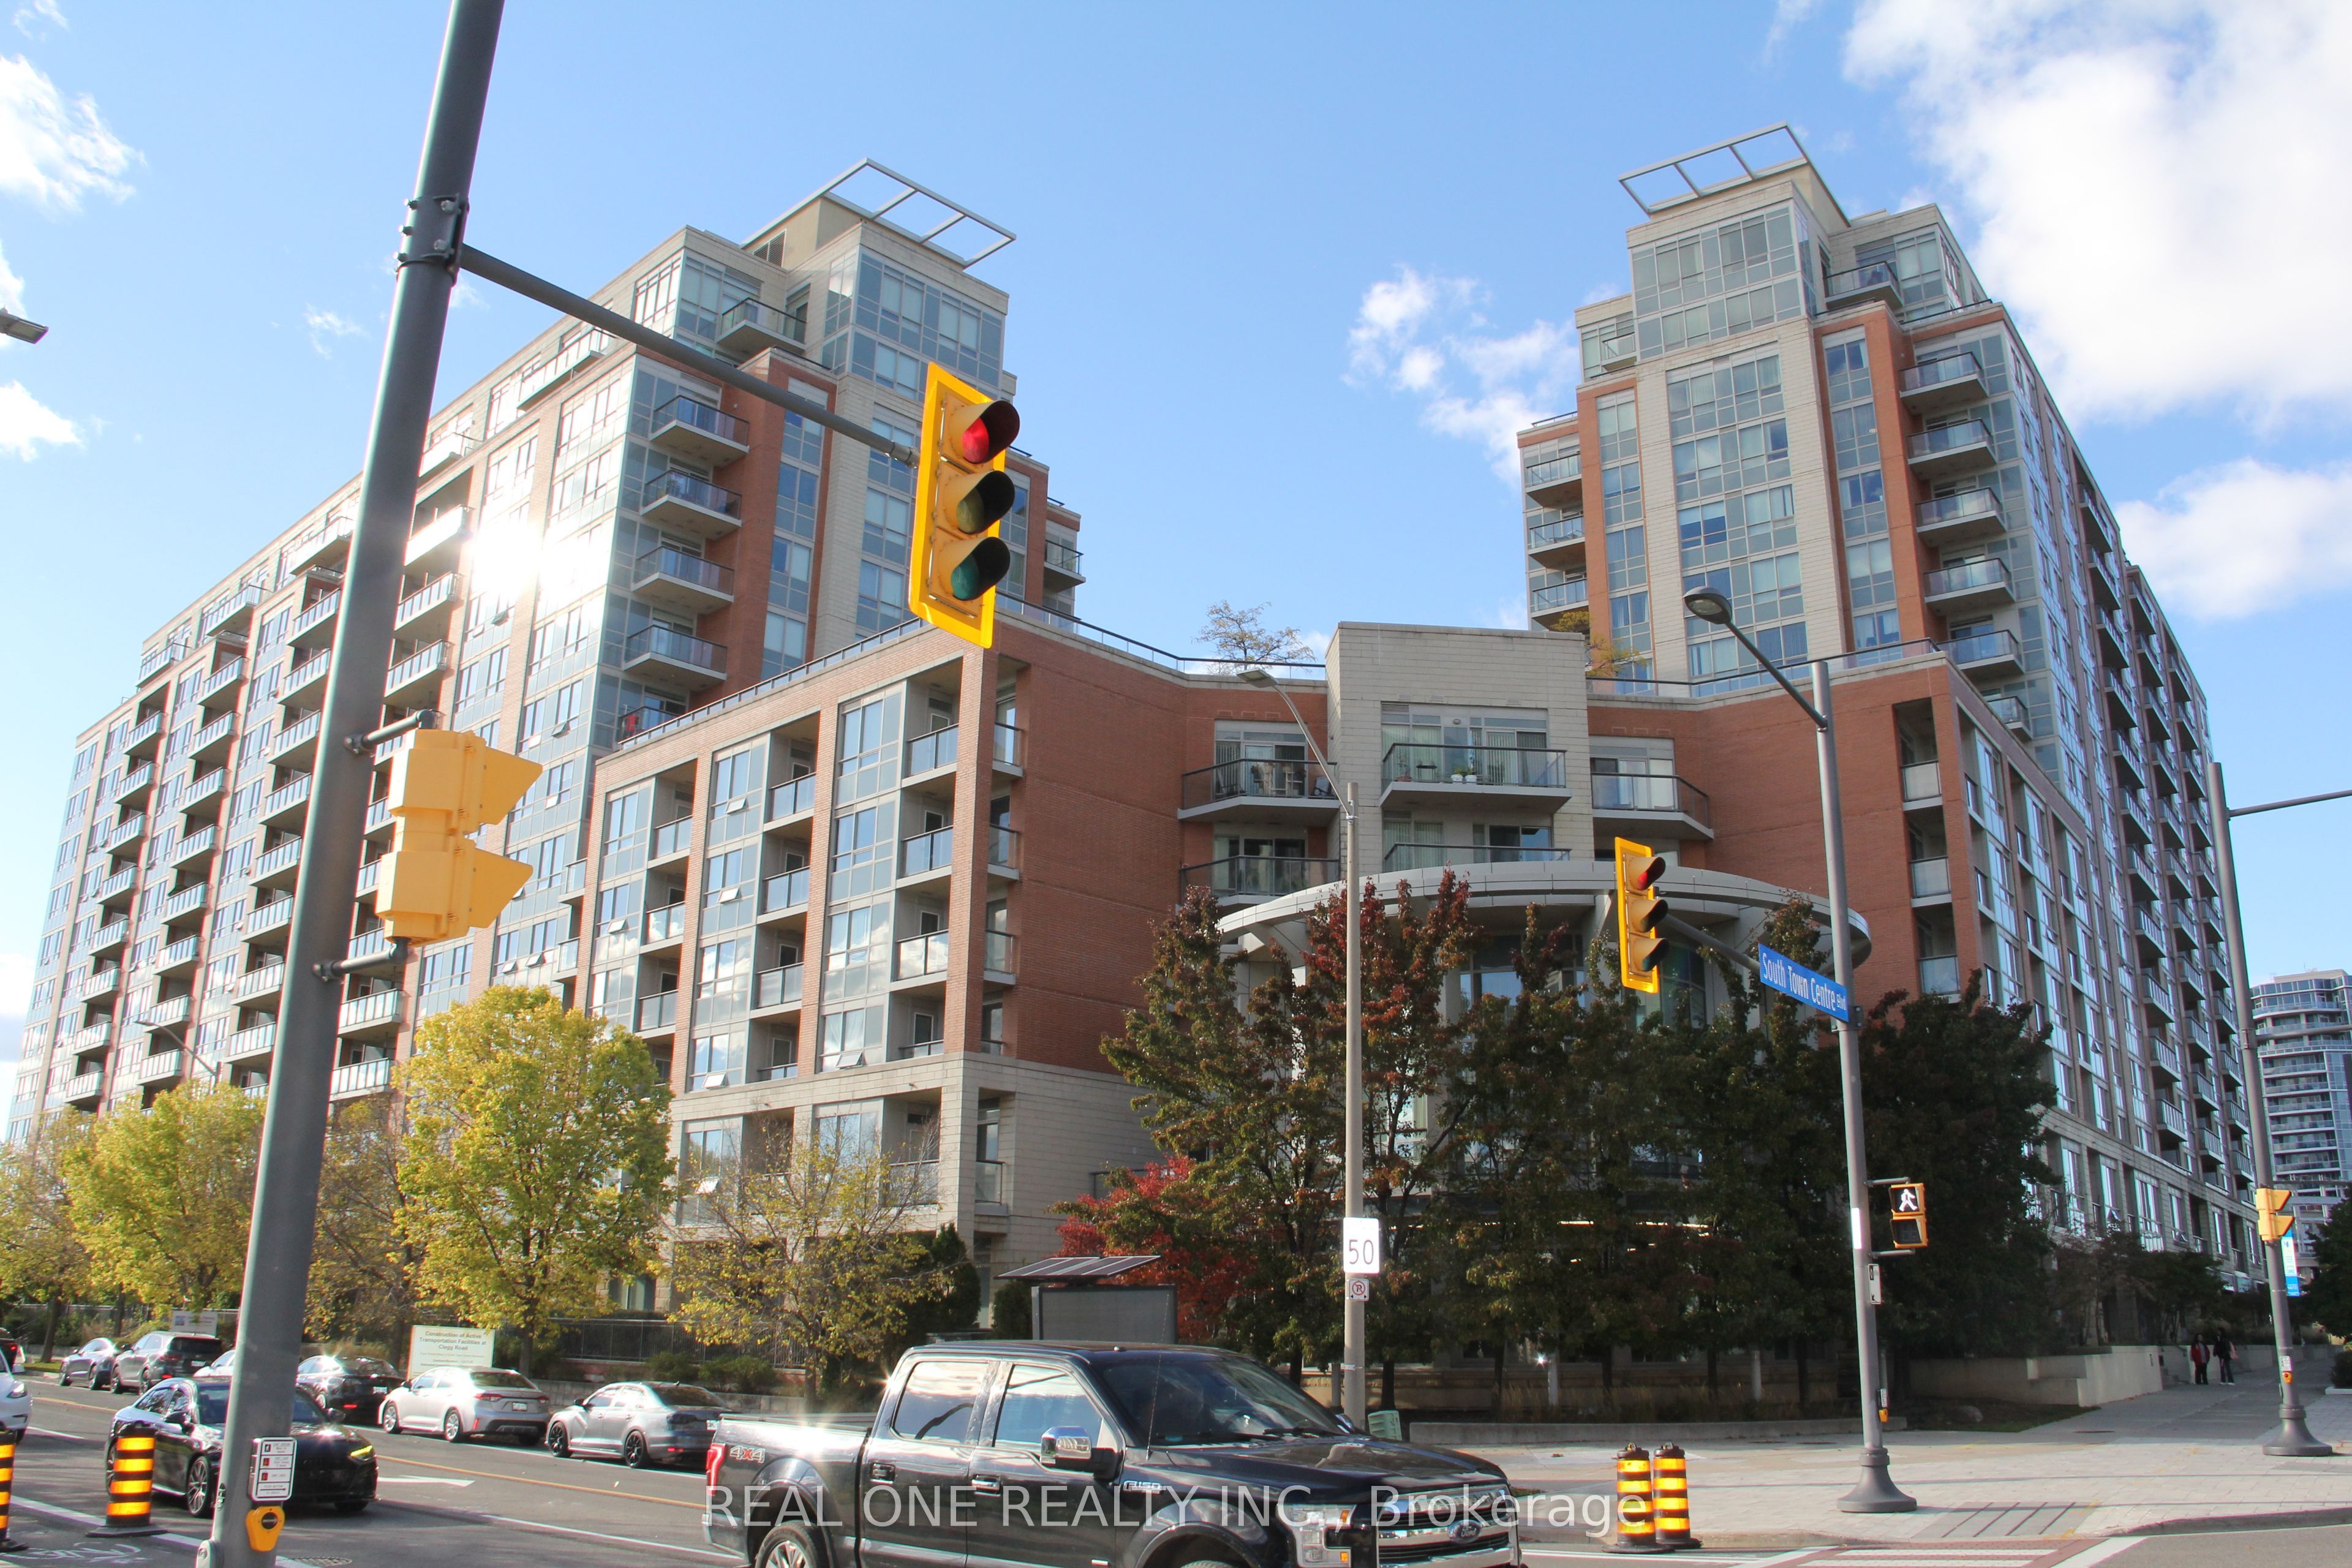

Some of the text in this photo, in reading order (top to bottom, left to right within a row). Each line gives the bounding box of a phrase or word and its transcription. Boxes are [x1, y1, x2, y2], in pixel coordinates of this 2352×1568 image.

[1763, 952, 1787, 989] South
[1787, 965, 1809, 1000] Town
[1810, 978, 1836, 1011] Centre
[1349, 1239, 1374, 1265] 50
